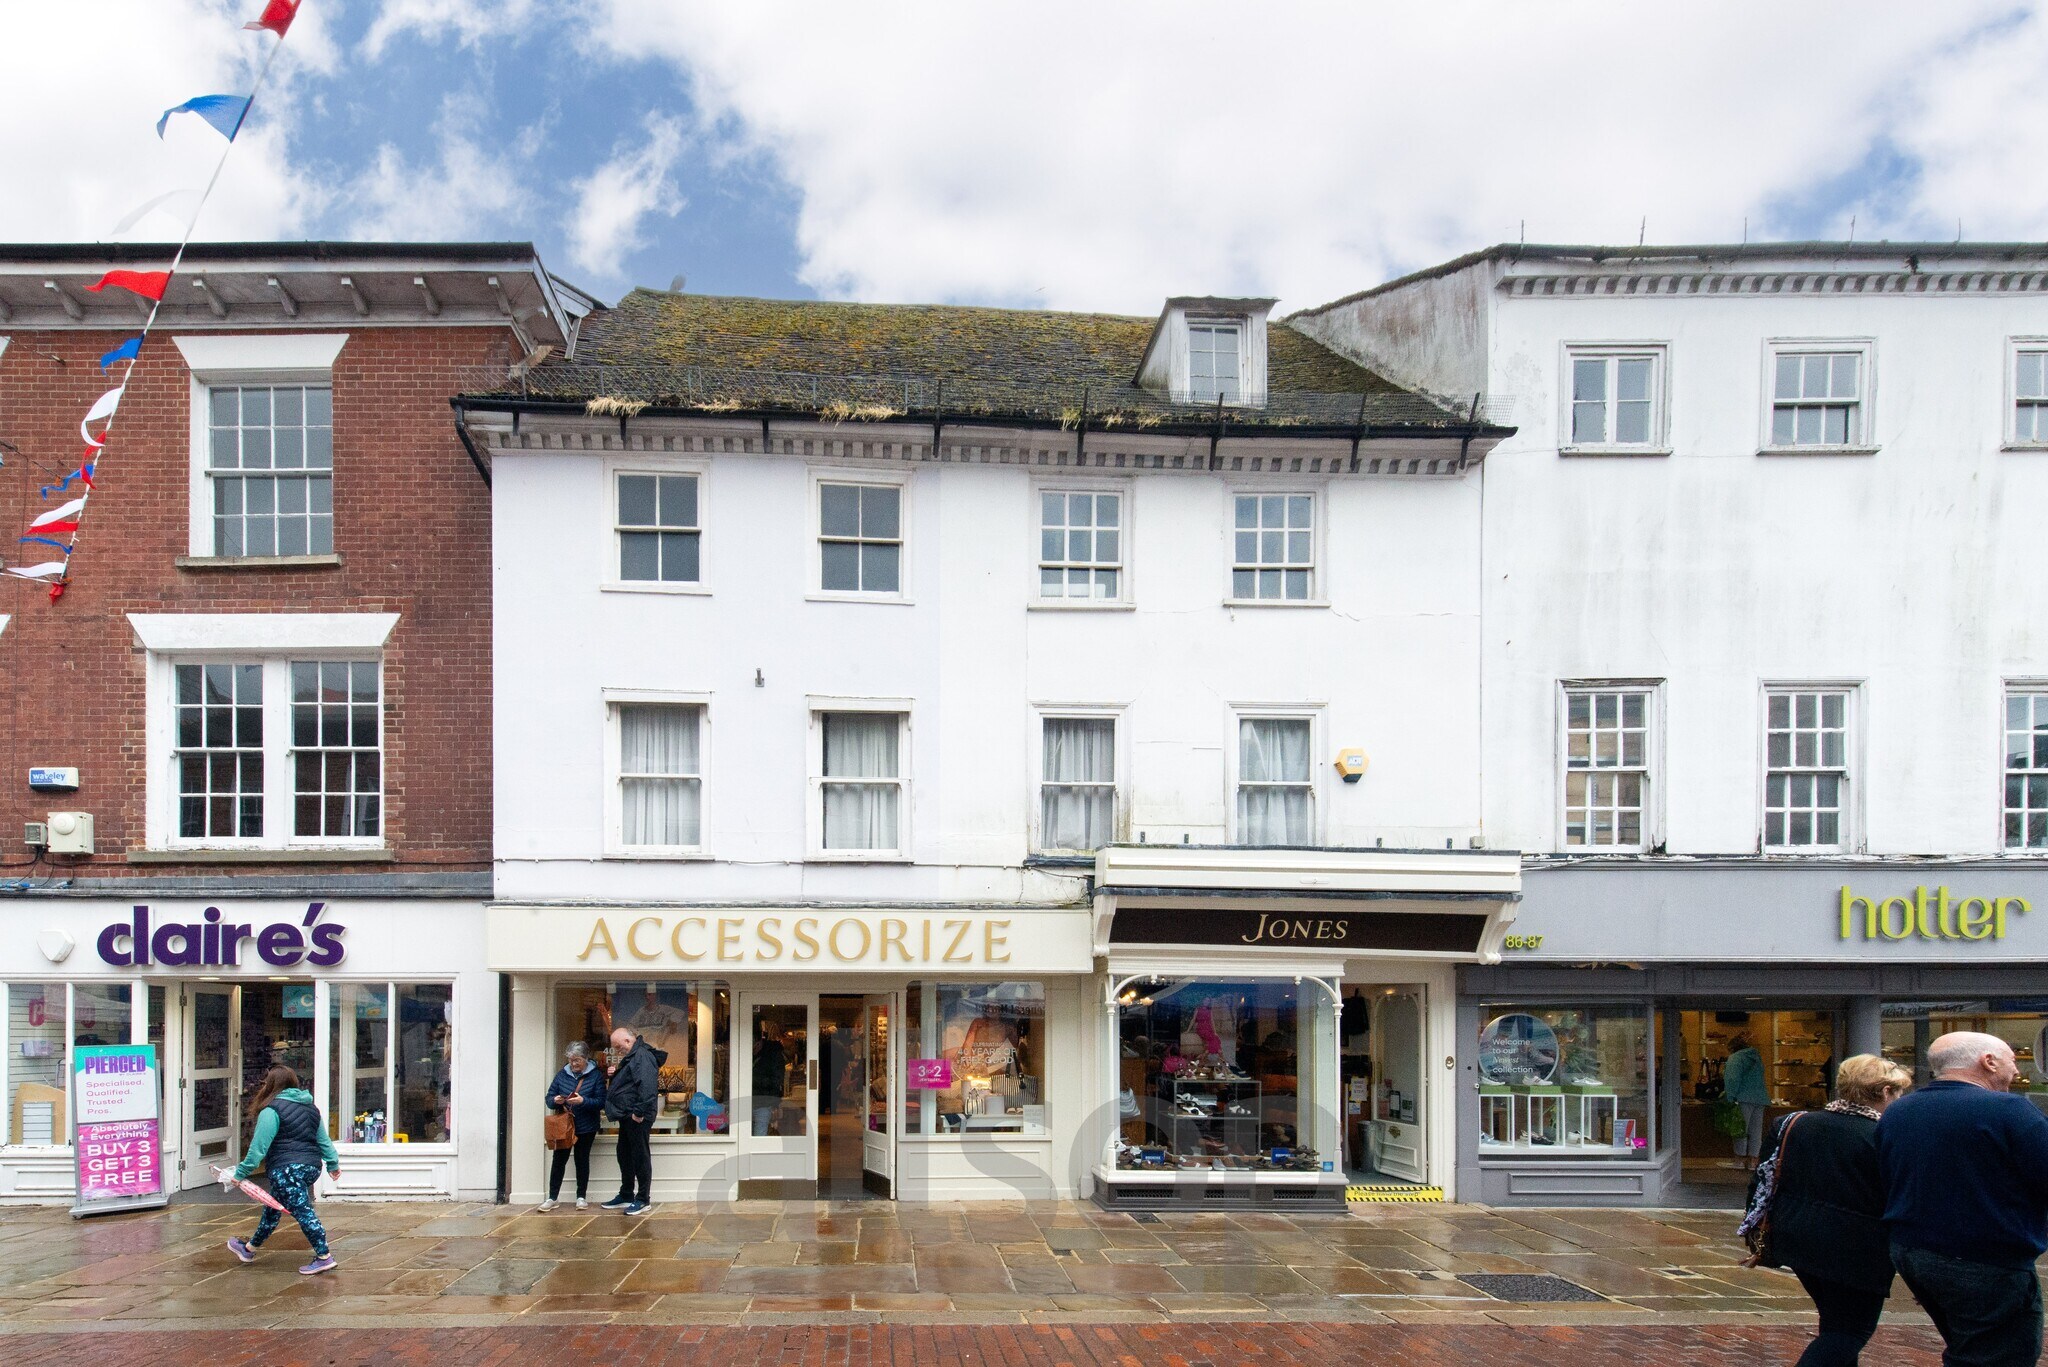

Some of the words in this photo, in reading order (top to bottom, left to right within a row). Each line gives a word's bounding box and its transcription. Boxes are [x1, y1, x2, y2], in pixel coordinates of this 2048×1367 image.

[1841, 886, 2033, 939] hotter
[97, 903, 346, 966] claire's
[1241, 914, 1348, 943] JONES
[576, 917, 1011, 962] ACCESSORIZE
[1506, 935, 1544, 948] 86-87
[603, 1047, 615, 1055] 40
[85, 1055, 146, 1074] PIERCED
[1492, 1066, 1534, 1074] collection
[918, 1065, 926, 1078] 3
[934, 1065, 942, 1078] 2
[86, 1080, 145, 1089] Specialised.
[86, 1089, 133, 1097] Qualified.
[87, 1098, 126, 1106] Trusted.
[91, 1122, 148, 1132] Absolutely
[91, 1131, 149, 1140] Everything
[87, 1141, 131, 1156] BUY
[137, 1140, 151, 1153] 3
[87, 1156, 133, 1171] GET
[137, 1155, 151, 1167] 3
[88, 1169, 153, 1187] FREE
